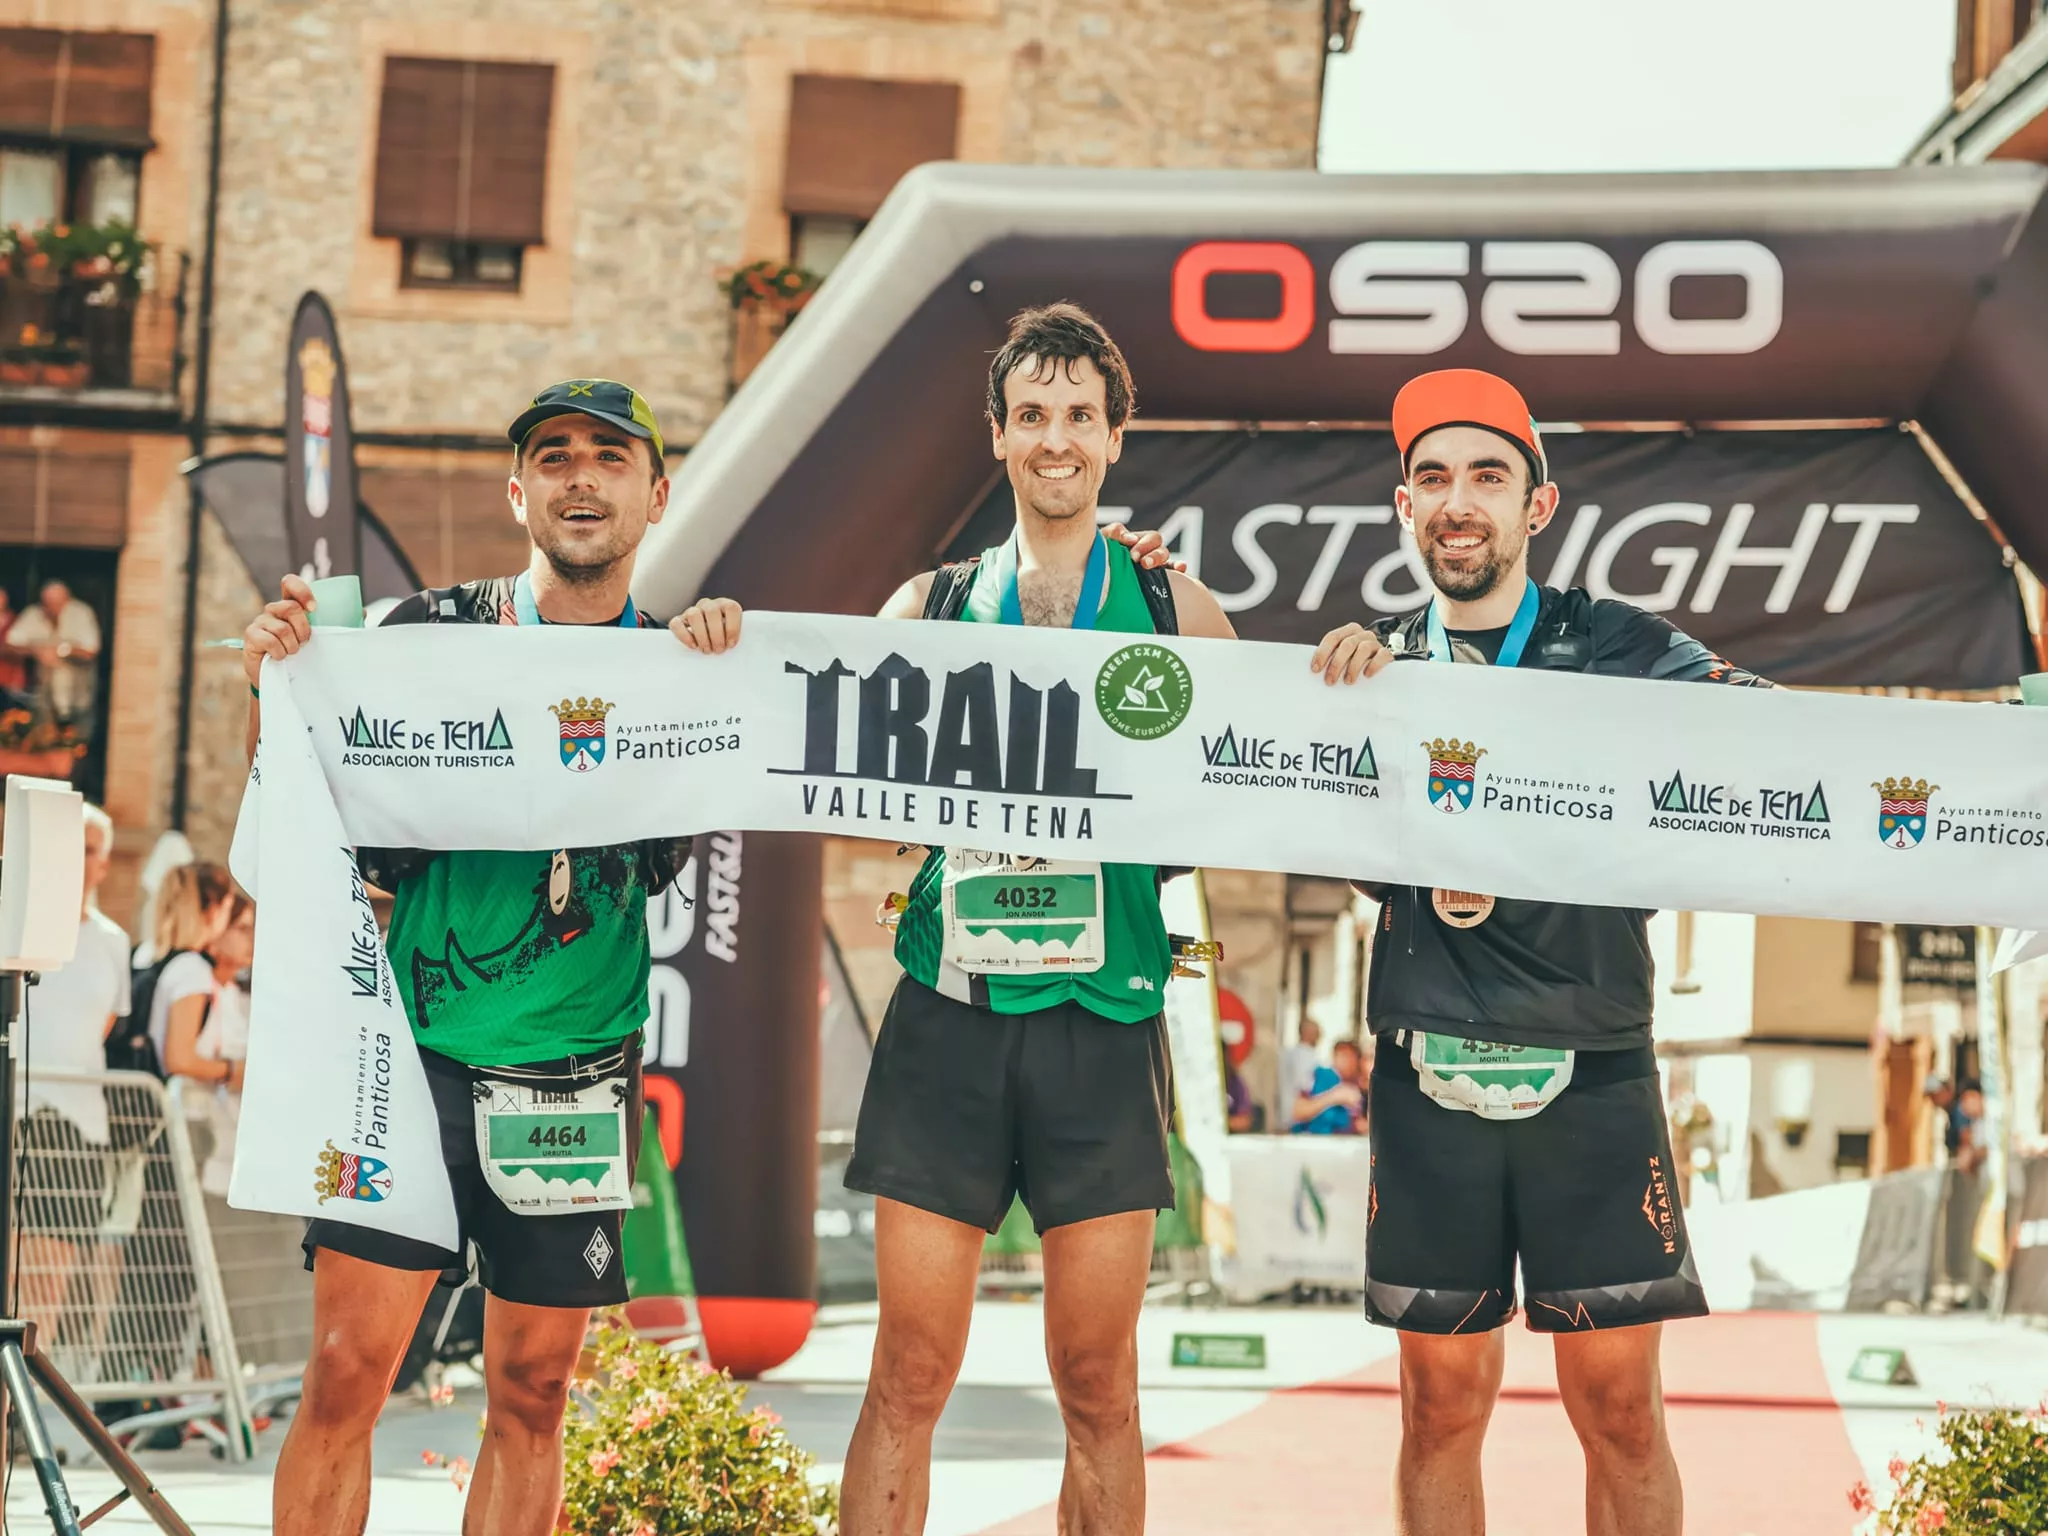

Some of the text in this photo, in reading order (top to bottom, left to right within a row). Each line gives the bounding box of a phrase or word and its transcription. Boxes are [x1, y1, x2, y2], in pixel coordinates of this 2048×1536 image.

[1100, 647, 1189, 691] GREEN CXM TRAIL
[339, 705, 406, 750] VALLE
[412, 732, 435, 750] DE
[616, 716, 742, 735] Ayuntamiento de
[784, 651, 1098, 795] TRAIL
[1104, 707, 1182, 736] FEDME-EUROPARC
[616, 732, 741, 760] Panticosa
[1200, 723, 1276, 770] VALLE
[1280, 752, 1303, 772] DE
[342, 754, 515, 768] ASOCIACION TURISTICA
[1201, 771, 1380, 799] ASOCIACION TURISTICA
[1486, 772, 1616, 795] Ayuntamiento de
[1648, 769, 1723, 815] VALLE
[1728, 798, 1753, 818] DE
[802, 784, 1094, 840] VALLE DE TENA
[1483, 786, 1615, 821] Panticosa
[1938, 806, 2042, 820] Ayuntamiento
[1648, 815, 1831, 841] ASOCIACION TURISTICA
[1937, 819, 2048, 847] Panticos
[993, 886, 1057, 908] 4032
[1005, 911, 1020, 919] JON
[352, 1026, 368, 1144] Ayuntamiento de
[365, 1032, 391, 1150] Panticosa
[527, 1125, 587, 1147] 4464
[1648, 1155, 1676, 1254] NORANTZ
